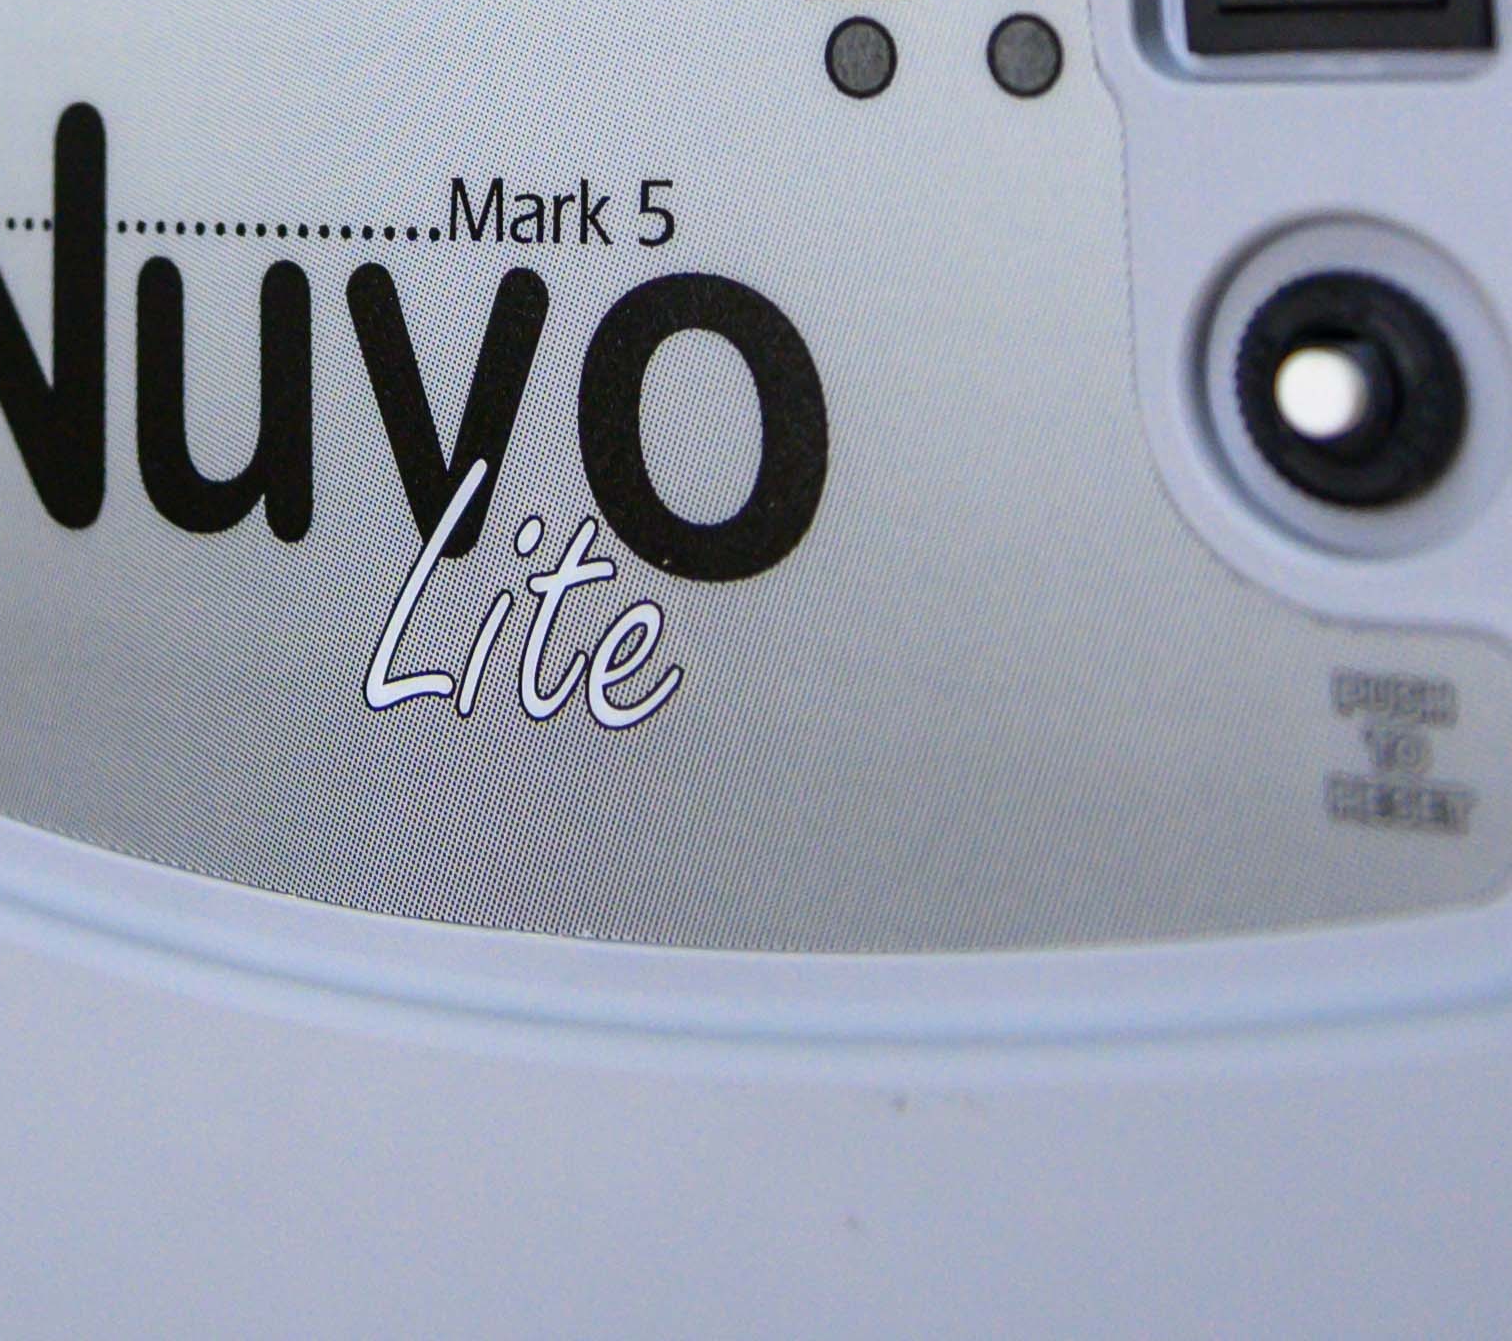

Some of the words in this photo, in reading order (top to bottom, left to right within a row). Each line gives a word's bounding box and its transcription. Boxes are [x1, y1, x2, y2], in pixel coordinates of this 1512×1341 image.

[449, 177, 613, 245] Mark
[638, 179, 675, 247] 5
[362, 458, 685, 730] Lite
